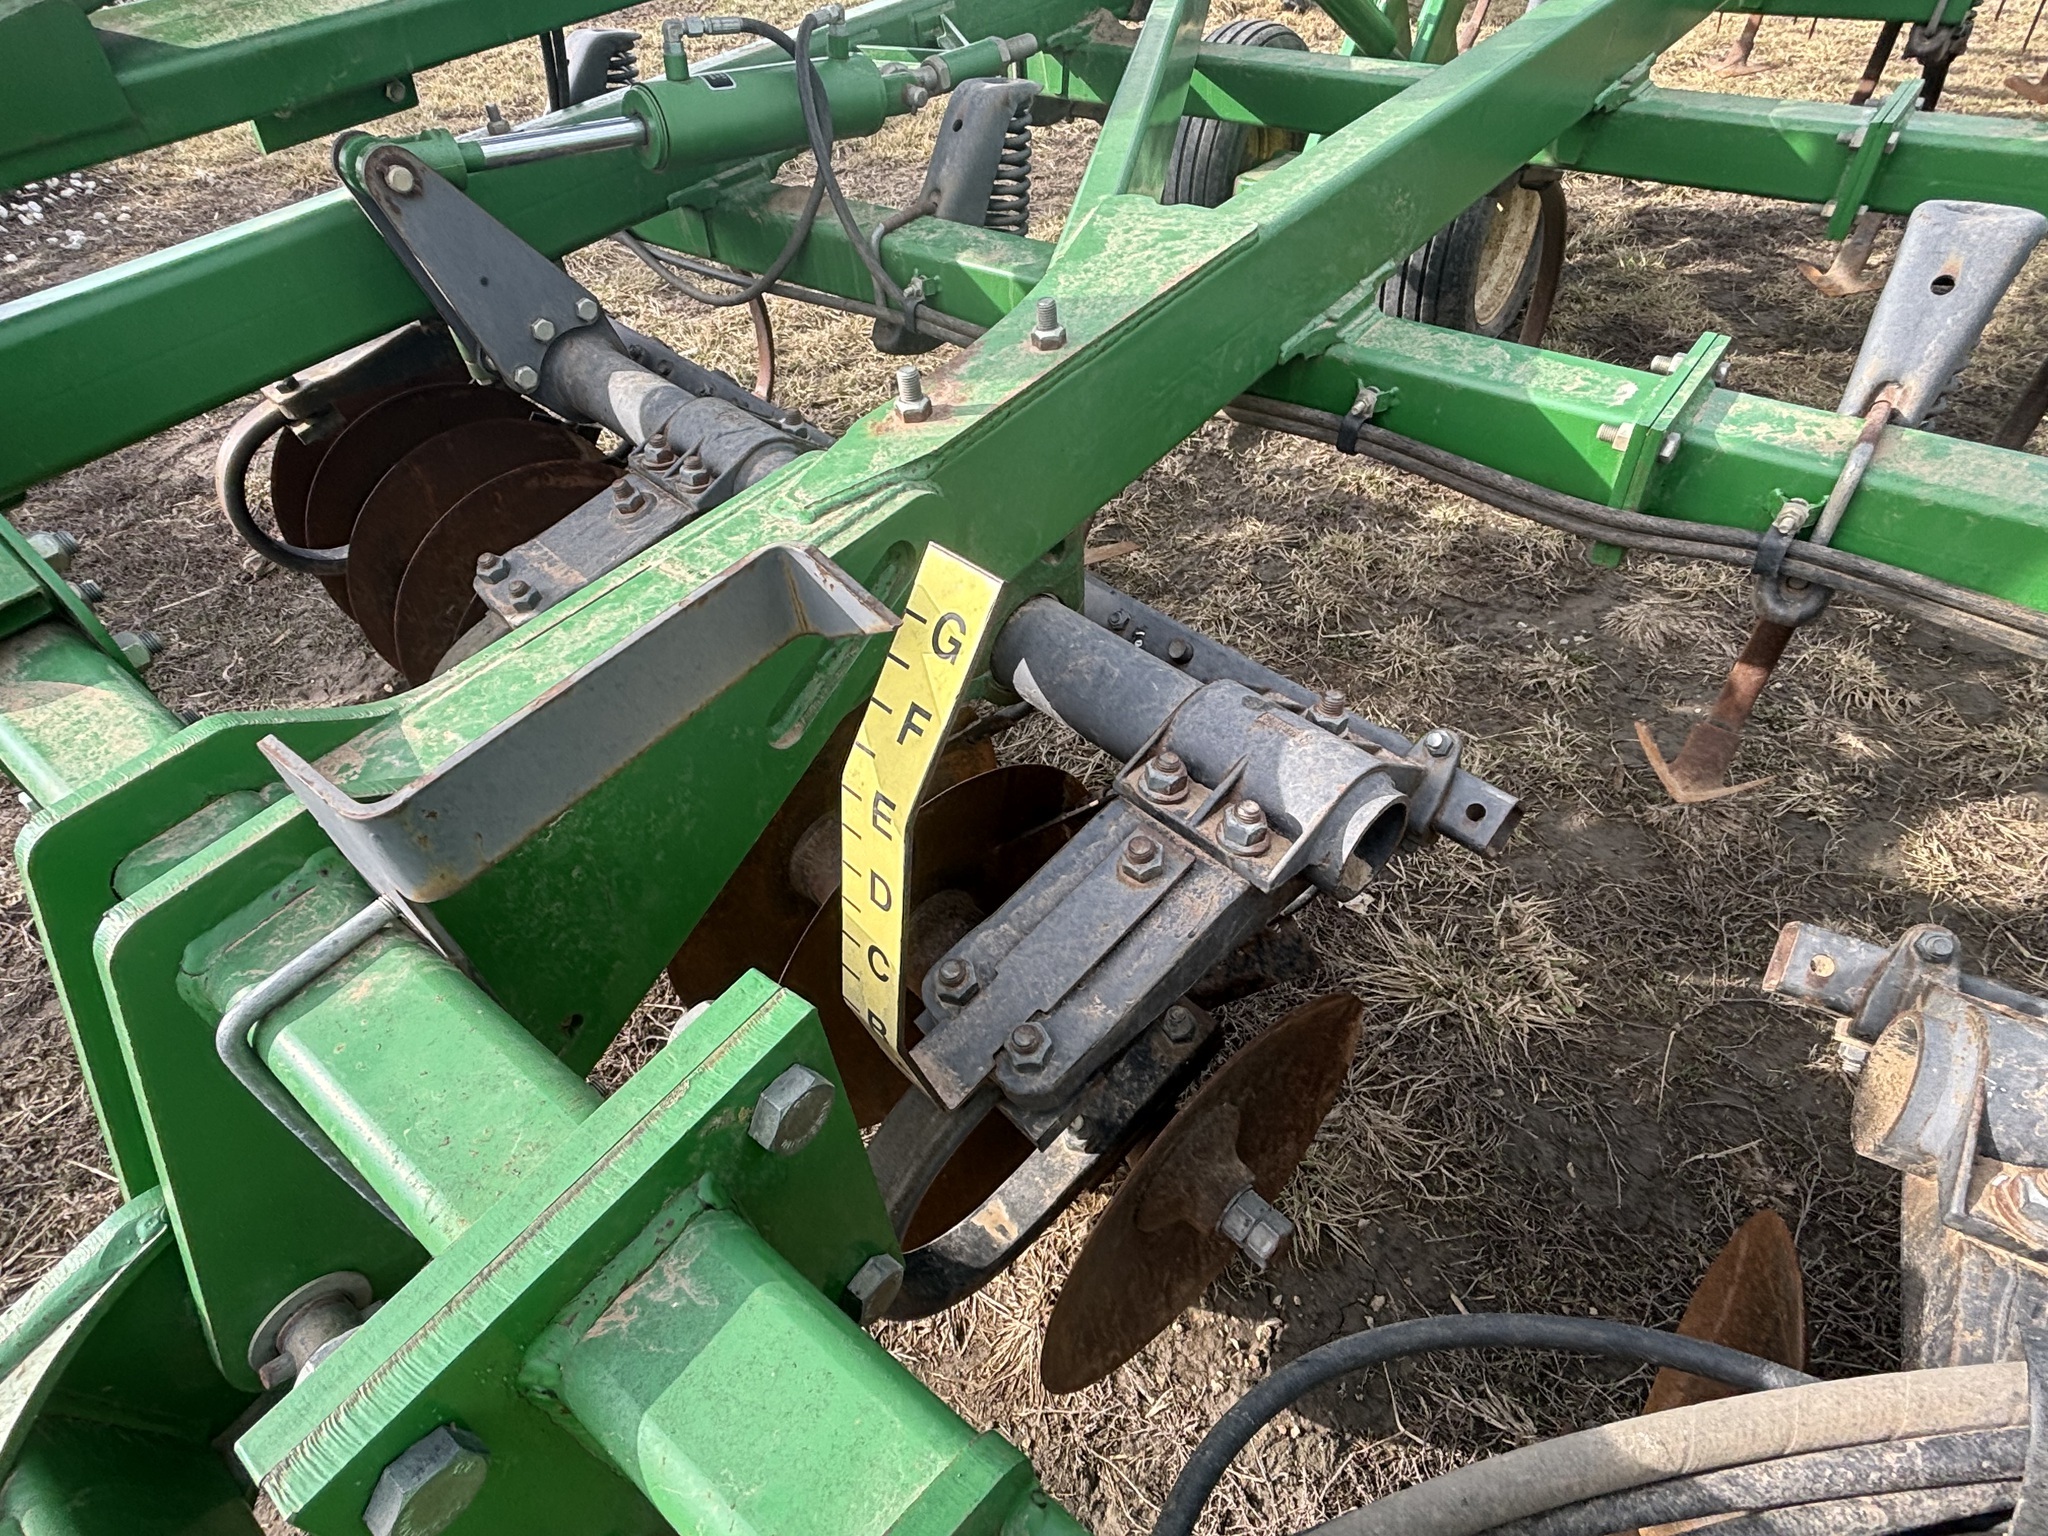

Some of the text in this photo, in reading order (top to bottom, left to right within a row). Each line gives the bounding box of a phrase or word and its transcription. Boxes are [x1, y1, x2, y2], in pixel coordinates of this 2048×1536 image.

[931, 612, 966, 665] G
[897, 701, 932, 745] F
[872, 790, 896, 841] E
[870, 868, 892, 912] D
[867, 945, 890, 982] C
